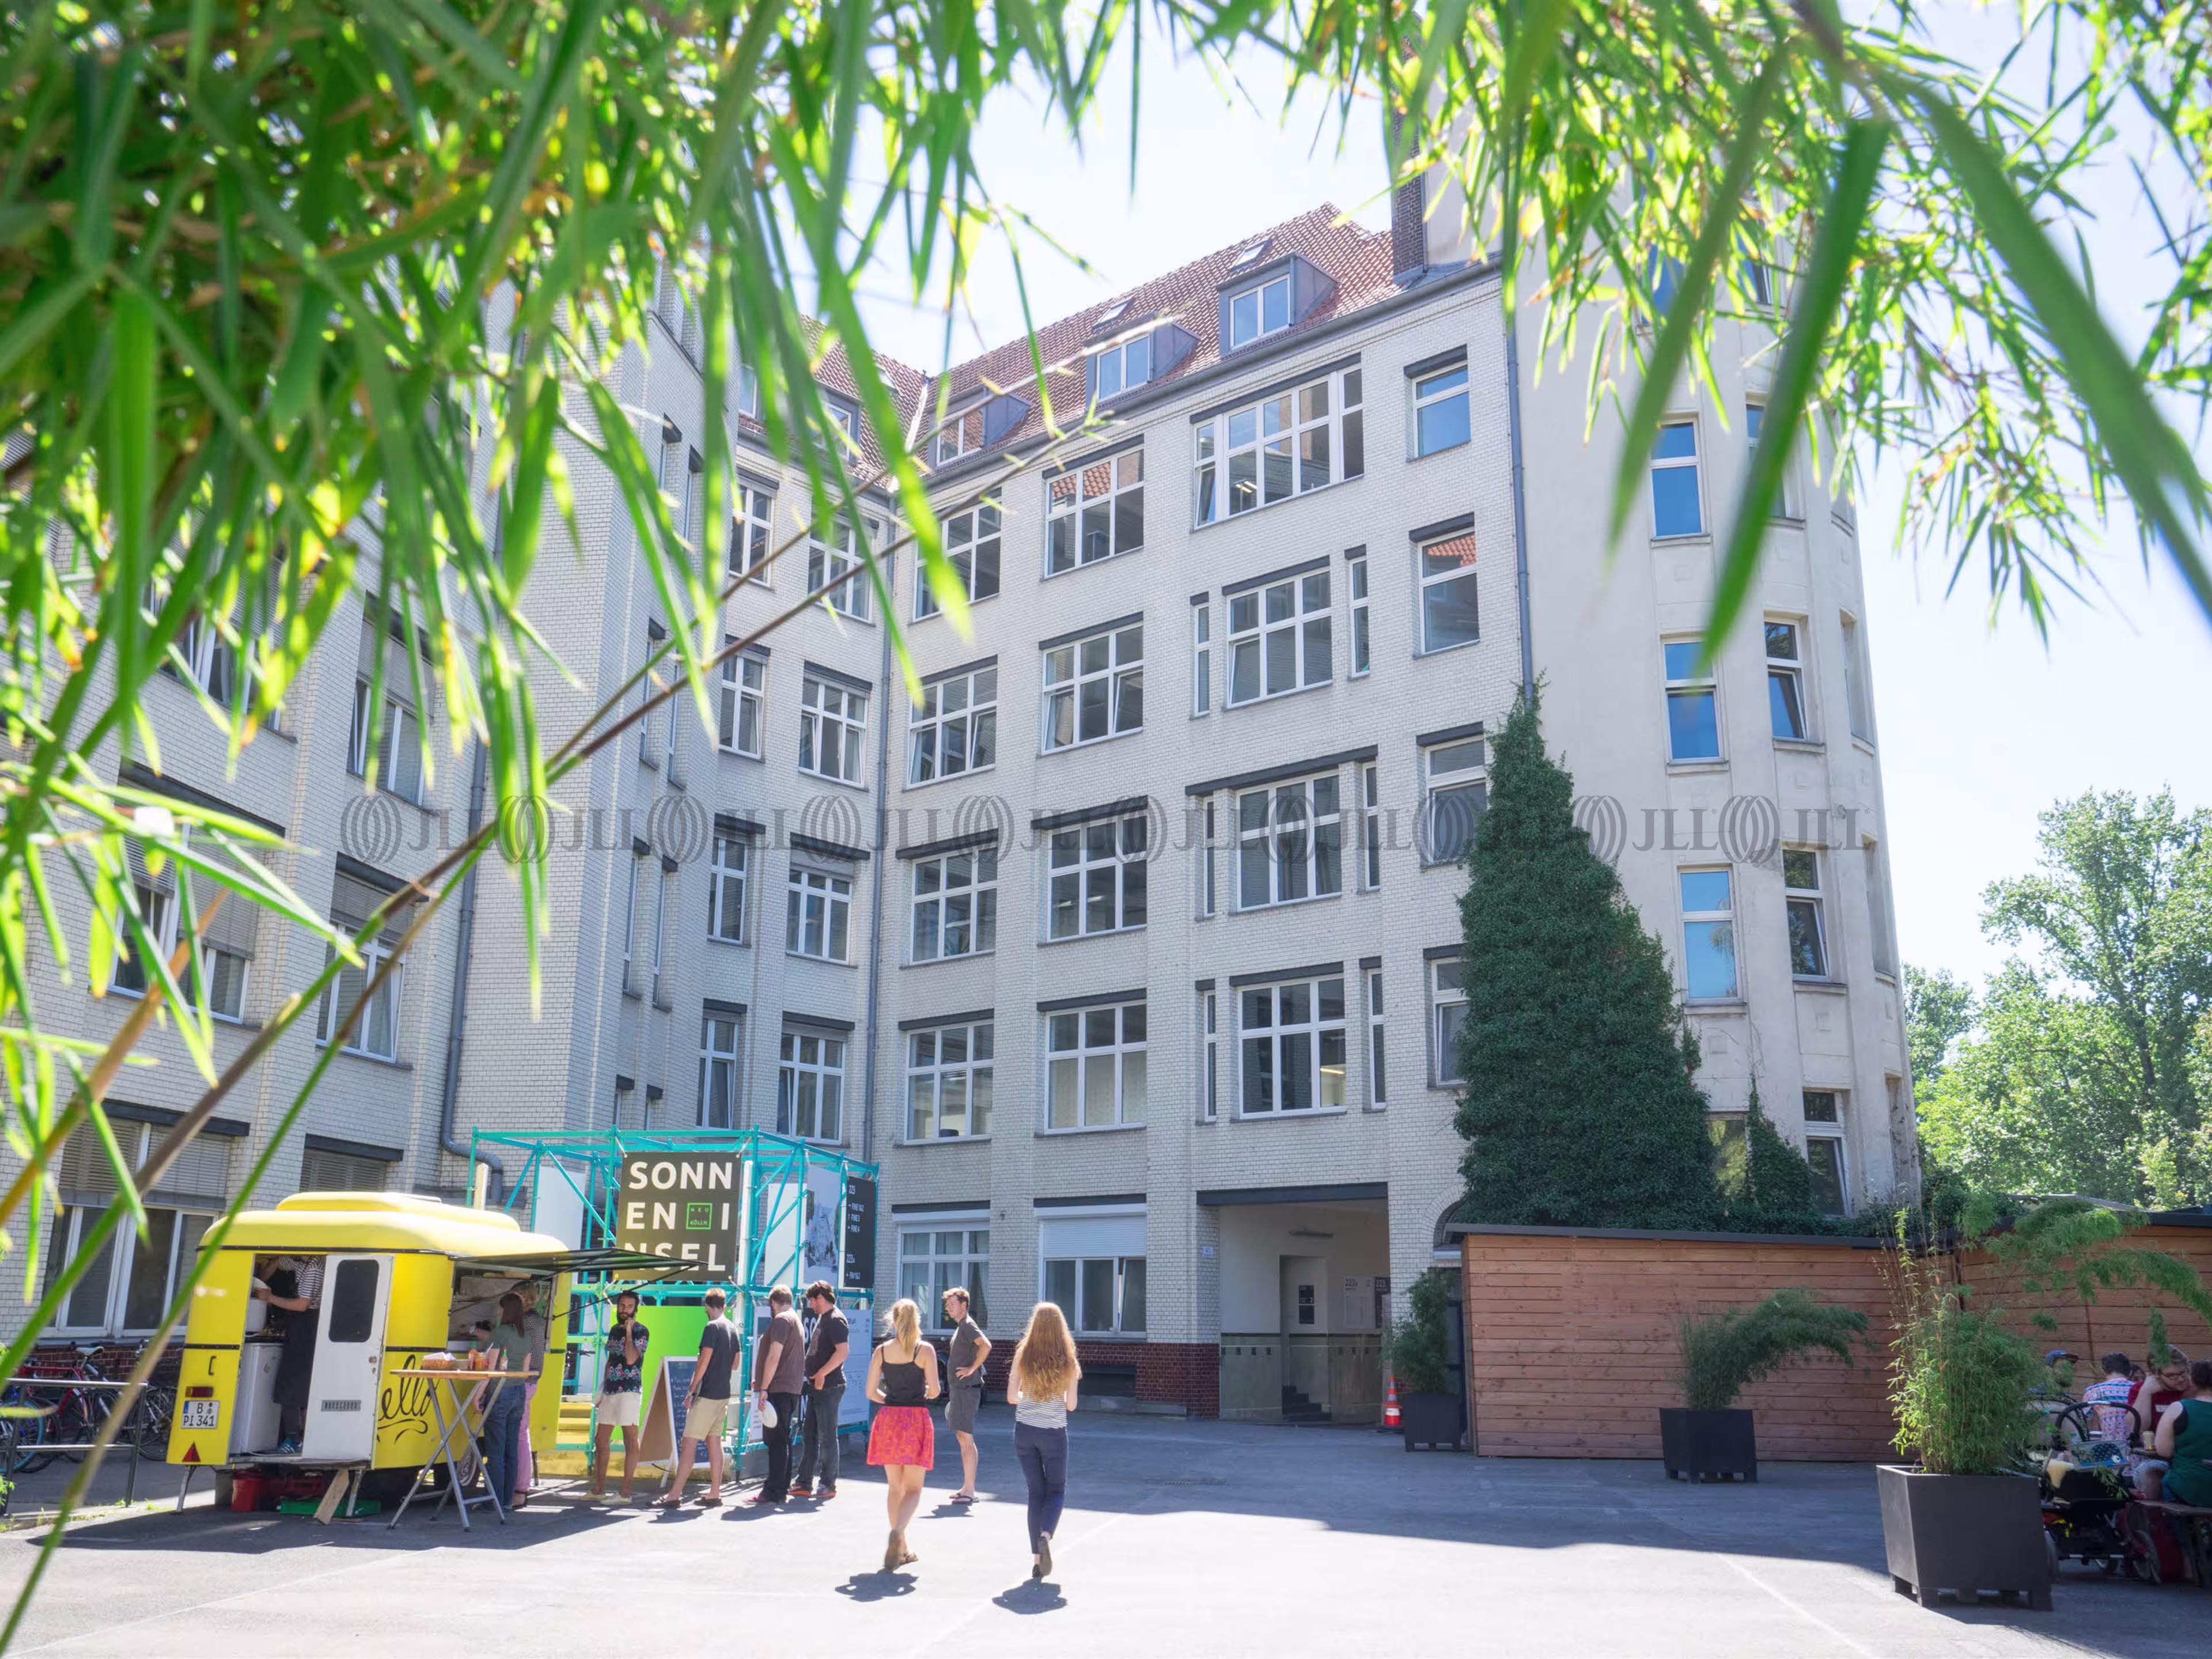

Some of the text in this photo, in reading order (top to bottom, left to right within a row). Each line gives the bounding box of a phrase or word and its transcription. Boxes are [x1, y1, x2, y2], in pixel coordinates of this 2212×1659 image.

[629, 1161, 733, 1190] SONN
[626, 1202, 730, 1230] EN I
[378, 1354, 442, 1420] ello
[183, 1415, 214, 1427] PI 341
[197, 1403, 203, 1414] B
